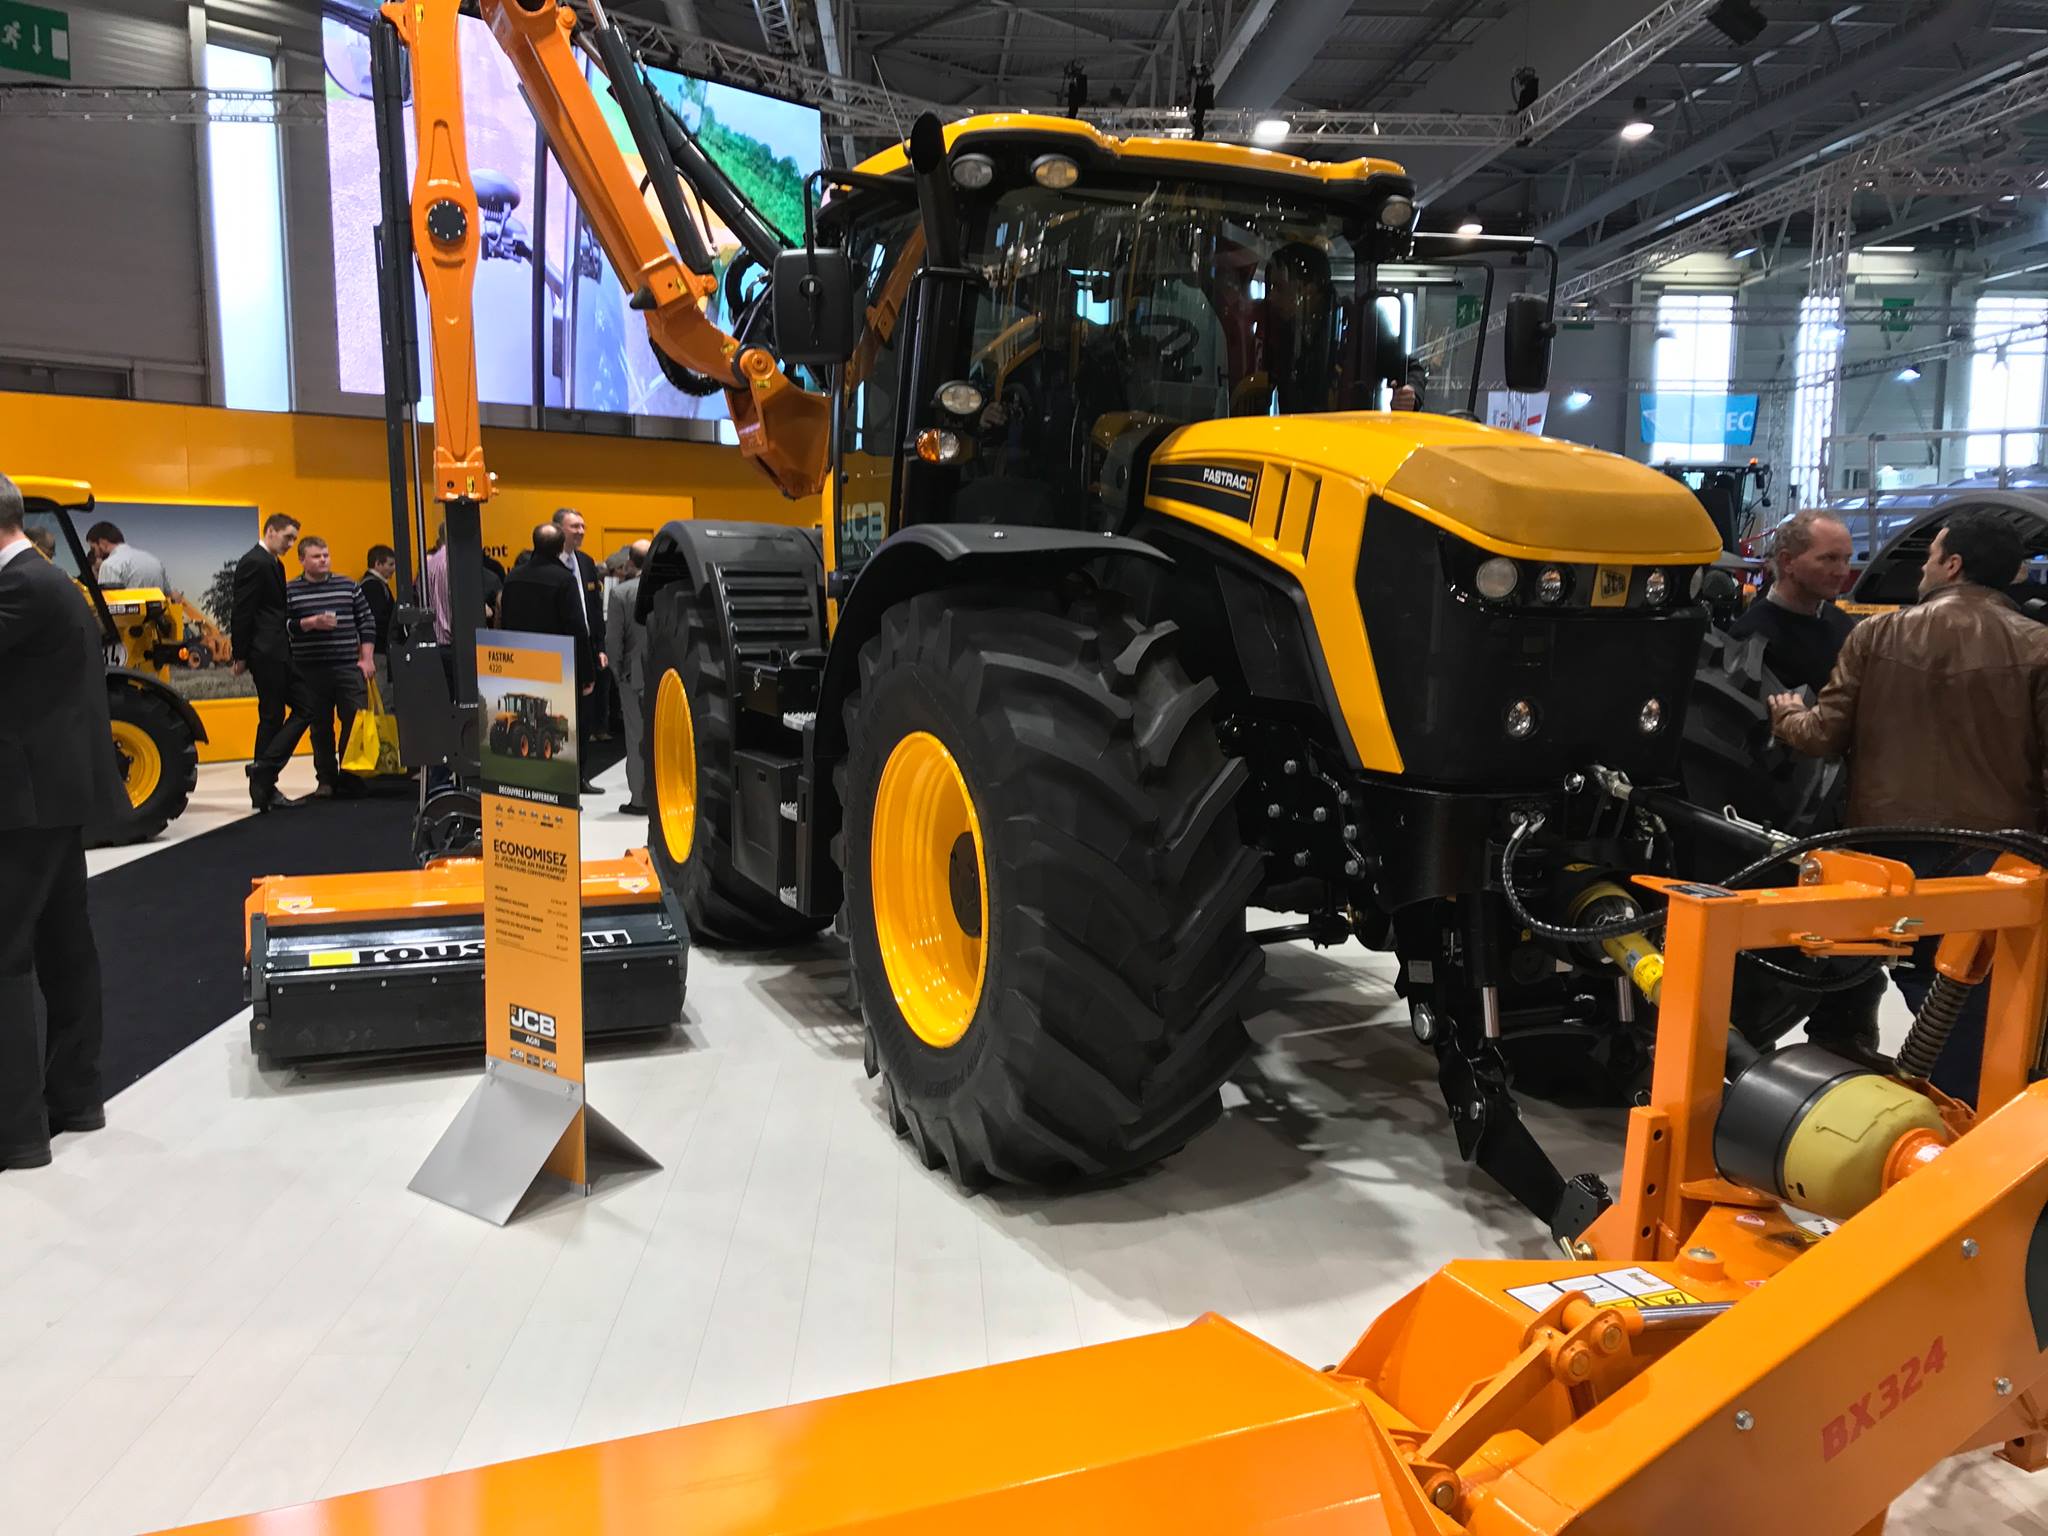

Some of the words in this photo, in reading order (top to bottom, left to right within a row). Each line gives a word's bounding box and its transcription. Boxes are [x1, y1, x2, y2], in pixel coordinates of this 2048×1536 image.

[1203, 467, 1247, 490] FASTRAC
[488, 650, 514, 664] FASTRAC
[493, 838, 567, 867] ECONOMISEZ
[511, 1007, 556, 1038] JCB
